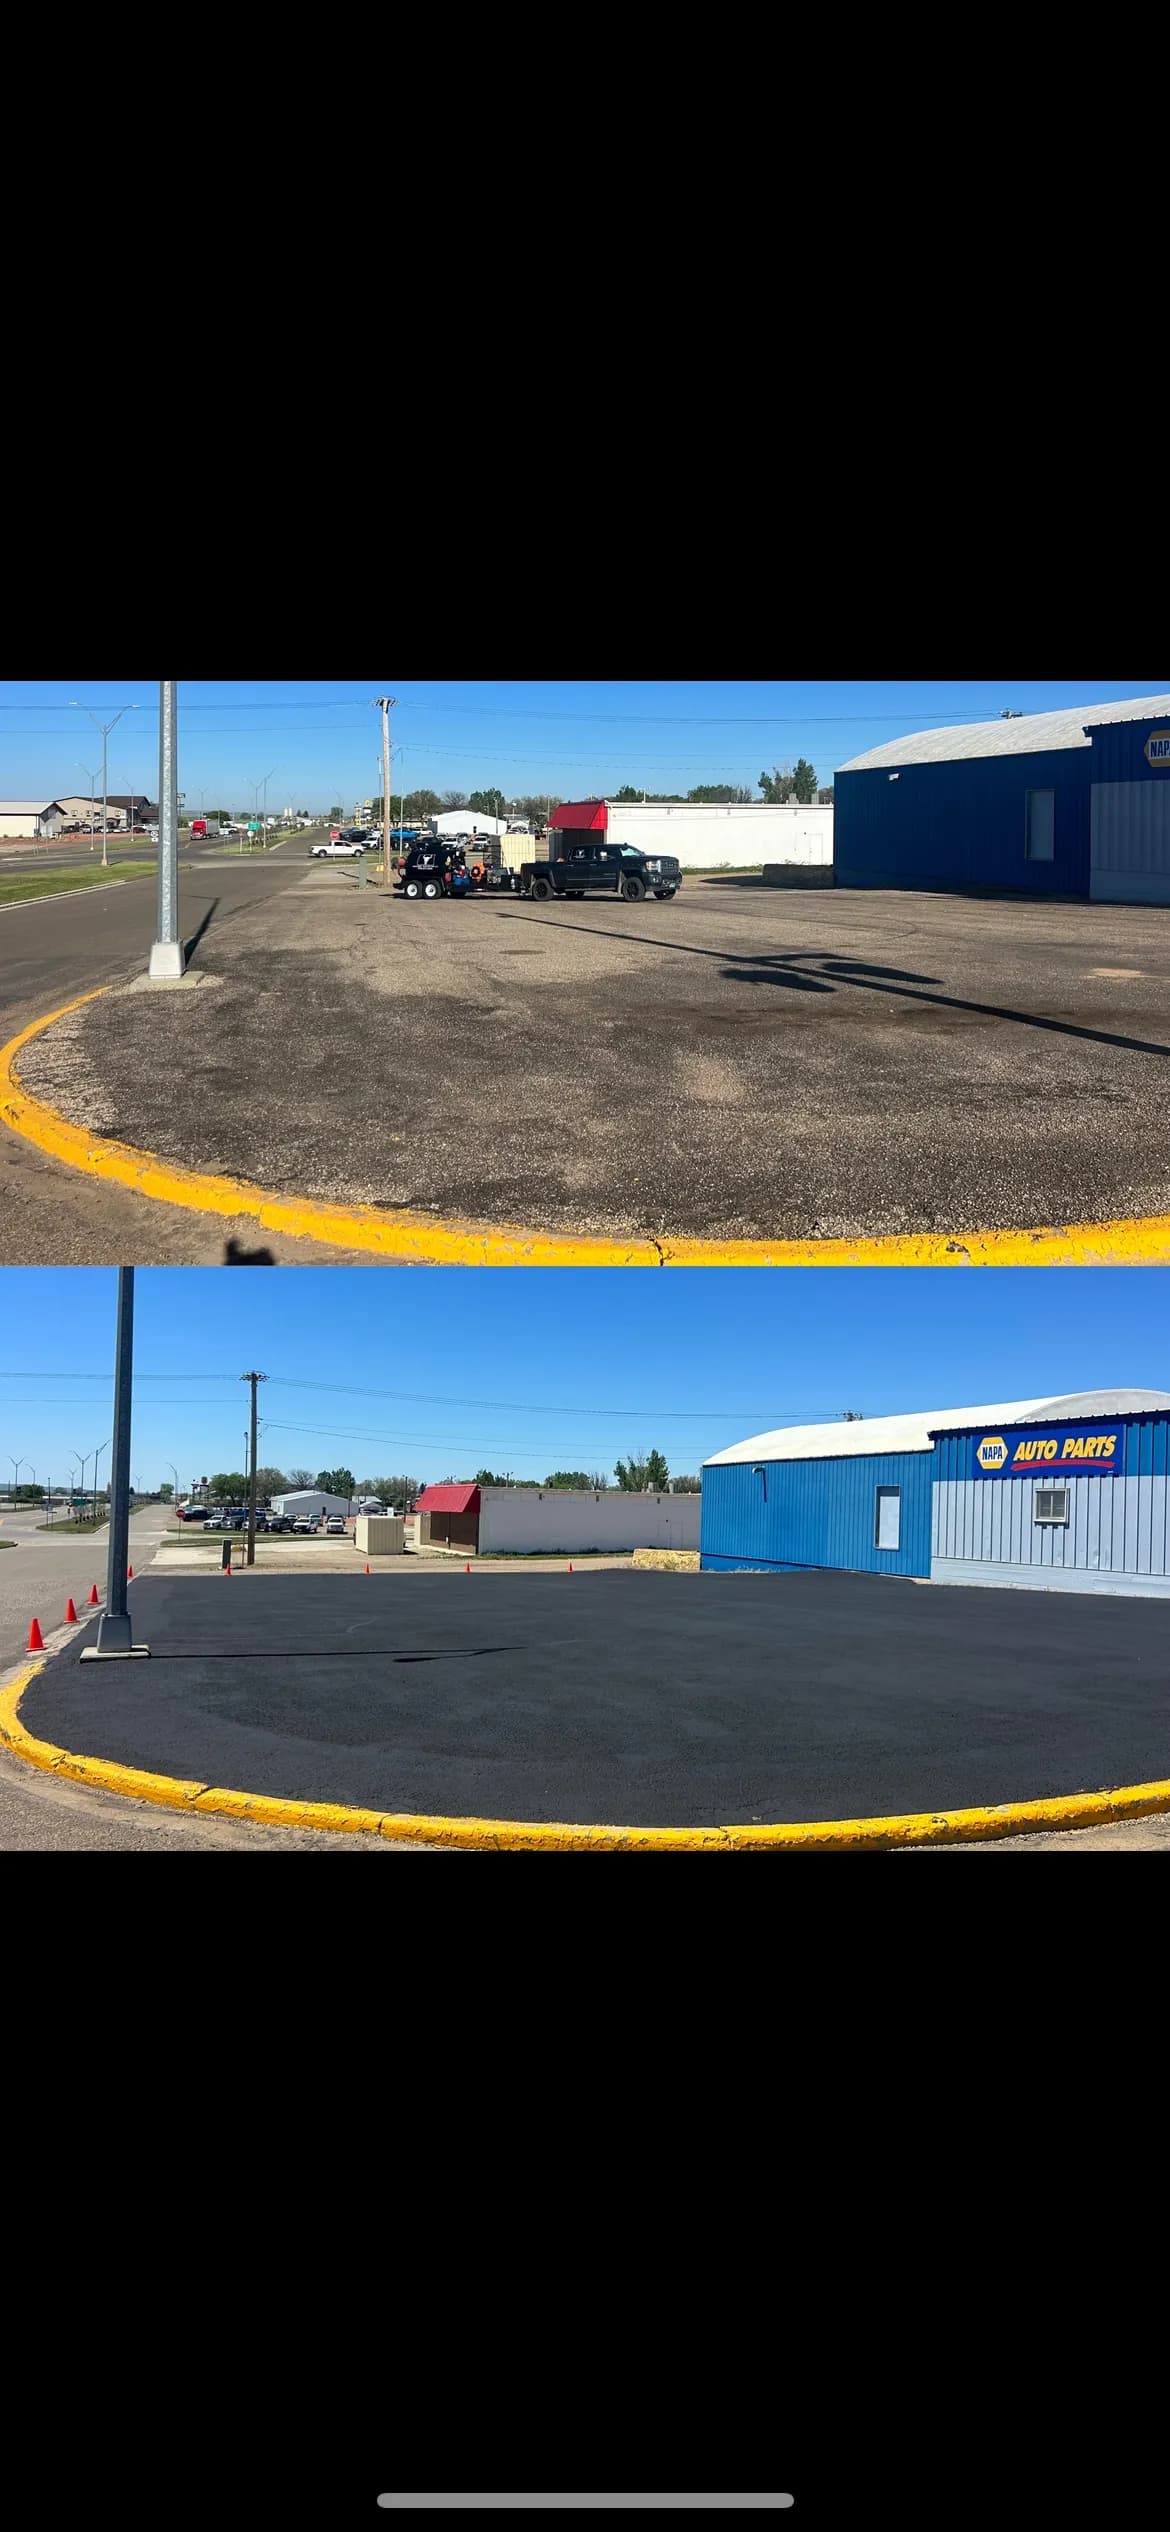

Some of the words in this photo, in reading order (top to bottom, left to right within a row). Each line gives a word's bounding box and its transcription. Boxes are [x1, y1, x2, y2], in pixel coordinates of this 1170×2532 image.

[1150, 740, 1170, 758] NAP
[982, 1445, 1003, 1460] NAPA
[1013, 1439, 1058, 1461] AUTO
[1061, 1435, 1117, 1458] PARTS
